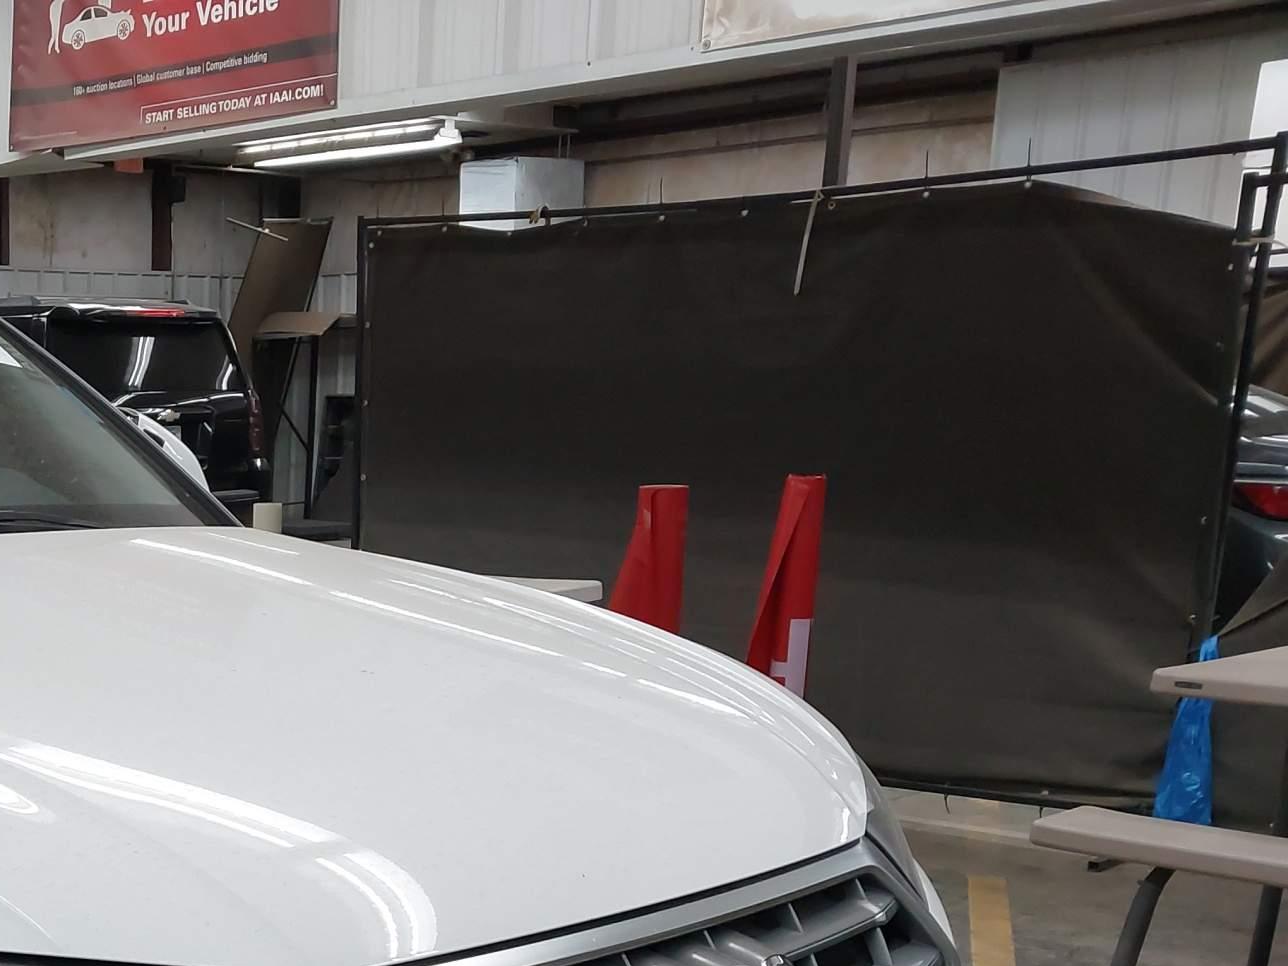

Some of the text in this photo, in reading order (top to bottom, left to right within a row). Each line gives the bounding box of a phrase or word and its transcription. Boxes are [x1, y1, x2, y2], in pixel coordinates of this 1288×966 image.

[142, 0, 279, 38] Your Vehicle
[86, 82, 108, 94] auction
[108, 77, 133, 91] locations
[136, 71, 155, 85] Global
[156, 67, 186, 80] customer
[186, 65, 201, 76] base
[205, 56, 242, 72] Competitive
[243, 51, 268, 65] bidding
[145, 84, 324, 124] START SELLING TODAY AT IAAI.COM!
